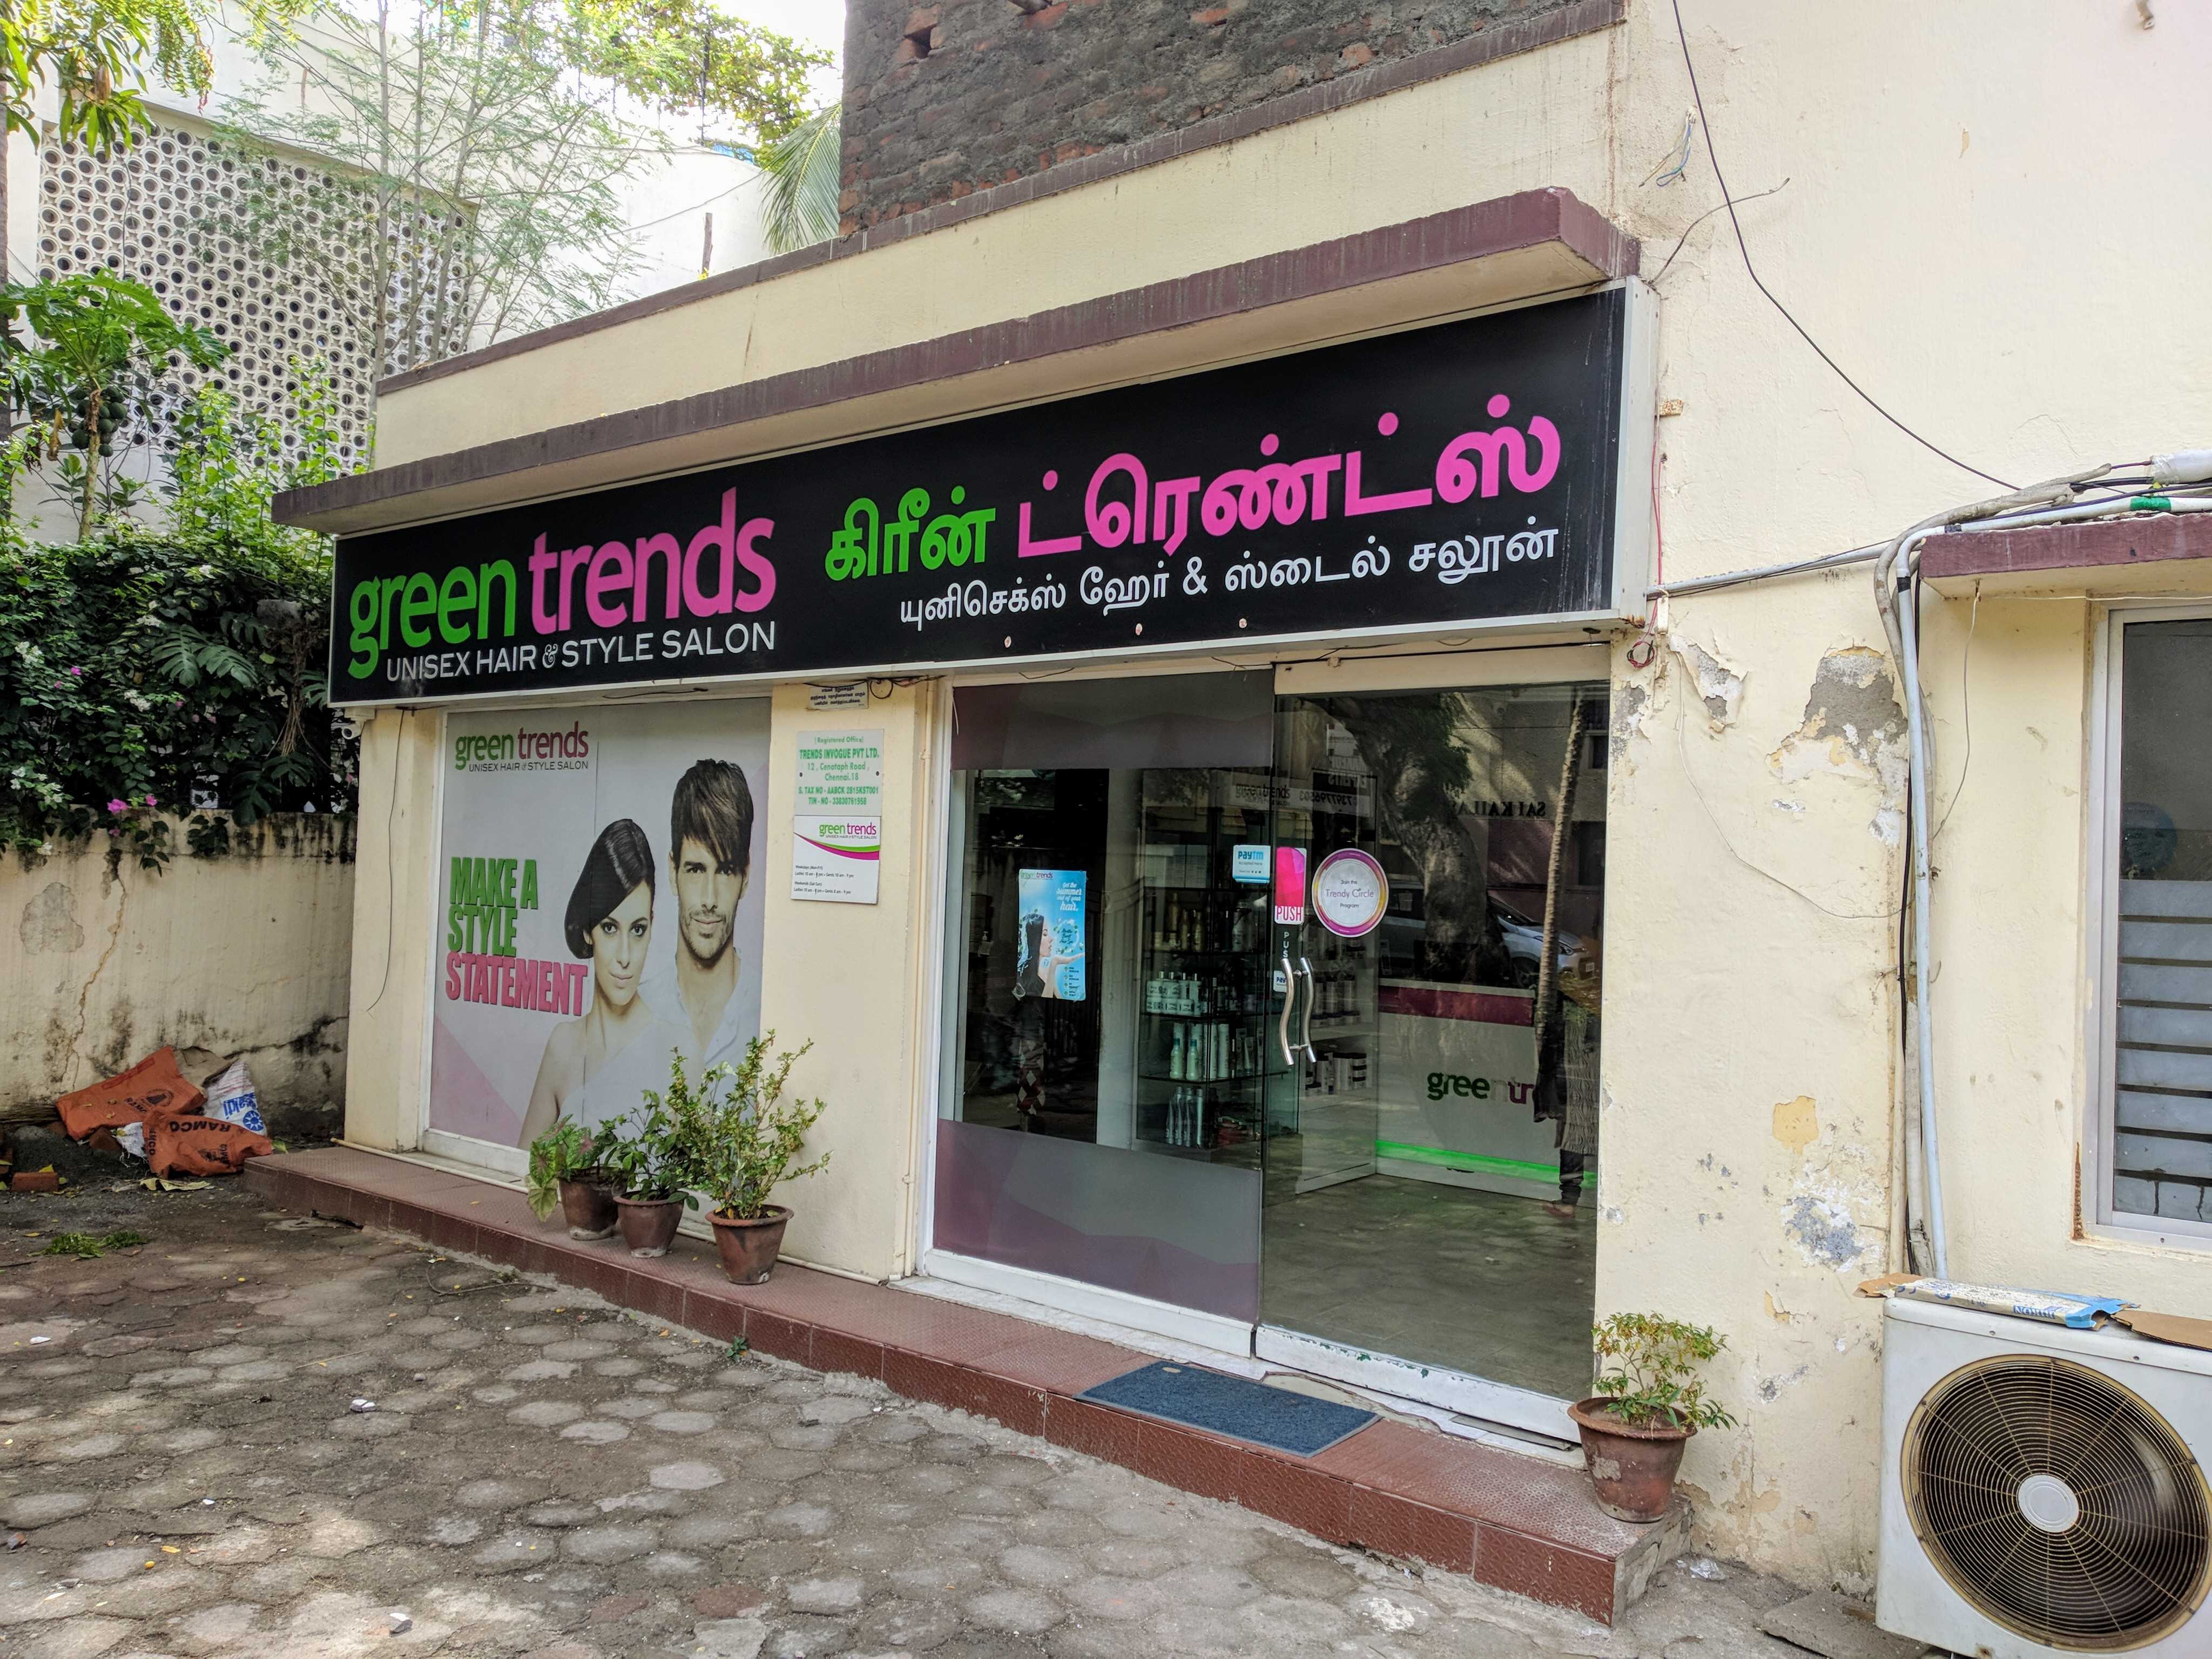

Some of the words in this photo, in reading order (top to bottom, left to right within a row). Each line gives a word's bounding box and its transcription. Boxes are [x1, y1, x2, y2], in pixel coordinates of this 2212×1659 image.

[825, 485, 996, 581] கிரீன்
[1018, 394, 1561, 557] ட்ரெண்ட்ஸ்
[349, 559, 517, 679] green
[529, 486, 777, 635] trends
[900, 573, 1066, 631] யுனிசெக்ஸ்
[1080, 561, 1170, 617] ஹேர்
[1182, 557, 1208, 595] &
[1224, 535, 1391, 592] ஸ்டைல்
[1408, 516, 1559, 584] சலூன்
[386, 651, 470, 683] UNISEX
[476, 645, 536, 675] HAIR
[561, 632, 653, 667] STYLE
[662, 621, 776, 659] SALON
[455, 733, 514, 771] green
[517, 720, 589, 760] trends
[469, 763, 498, 772] UNISEX
[500, 762, 520, 771] HAIR
[528, 761, 555, 771] STYLE
[557, 760, 589, 770] SALON
[799, 749, 822, 759] TRENDS
[824, 748, 851, 759] INVOGUE
[852, 748, 865, 759] PVT
[865, 747, 880, 759] LTD.
[820, 762, 848, 773] Cenotaph
[819, 824, 846, 837] green
[847, 821, 877, 835] trends
[449, 857, 517, 909] MAKE
[520, 859, 538, 909] A
[1325, 889, 1350, 899] Trendy
[1352, 888, 1374, 898] Circle
[447, 906, 517, 957] STYLE
[1277, 906, 1301, 921] PUSH
[445, 950, 589, 1016] STATEMENT
[170, 1121, 231, 1132] RAMCO
